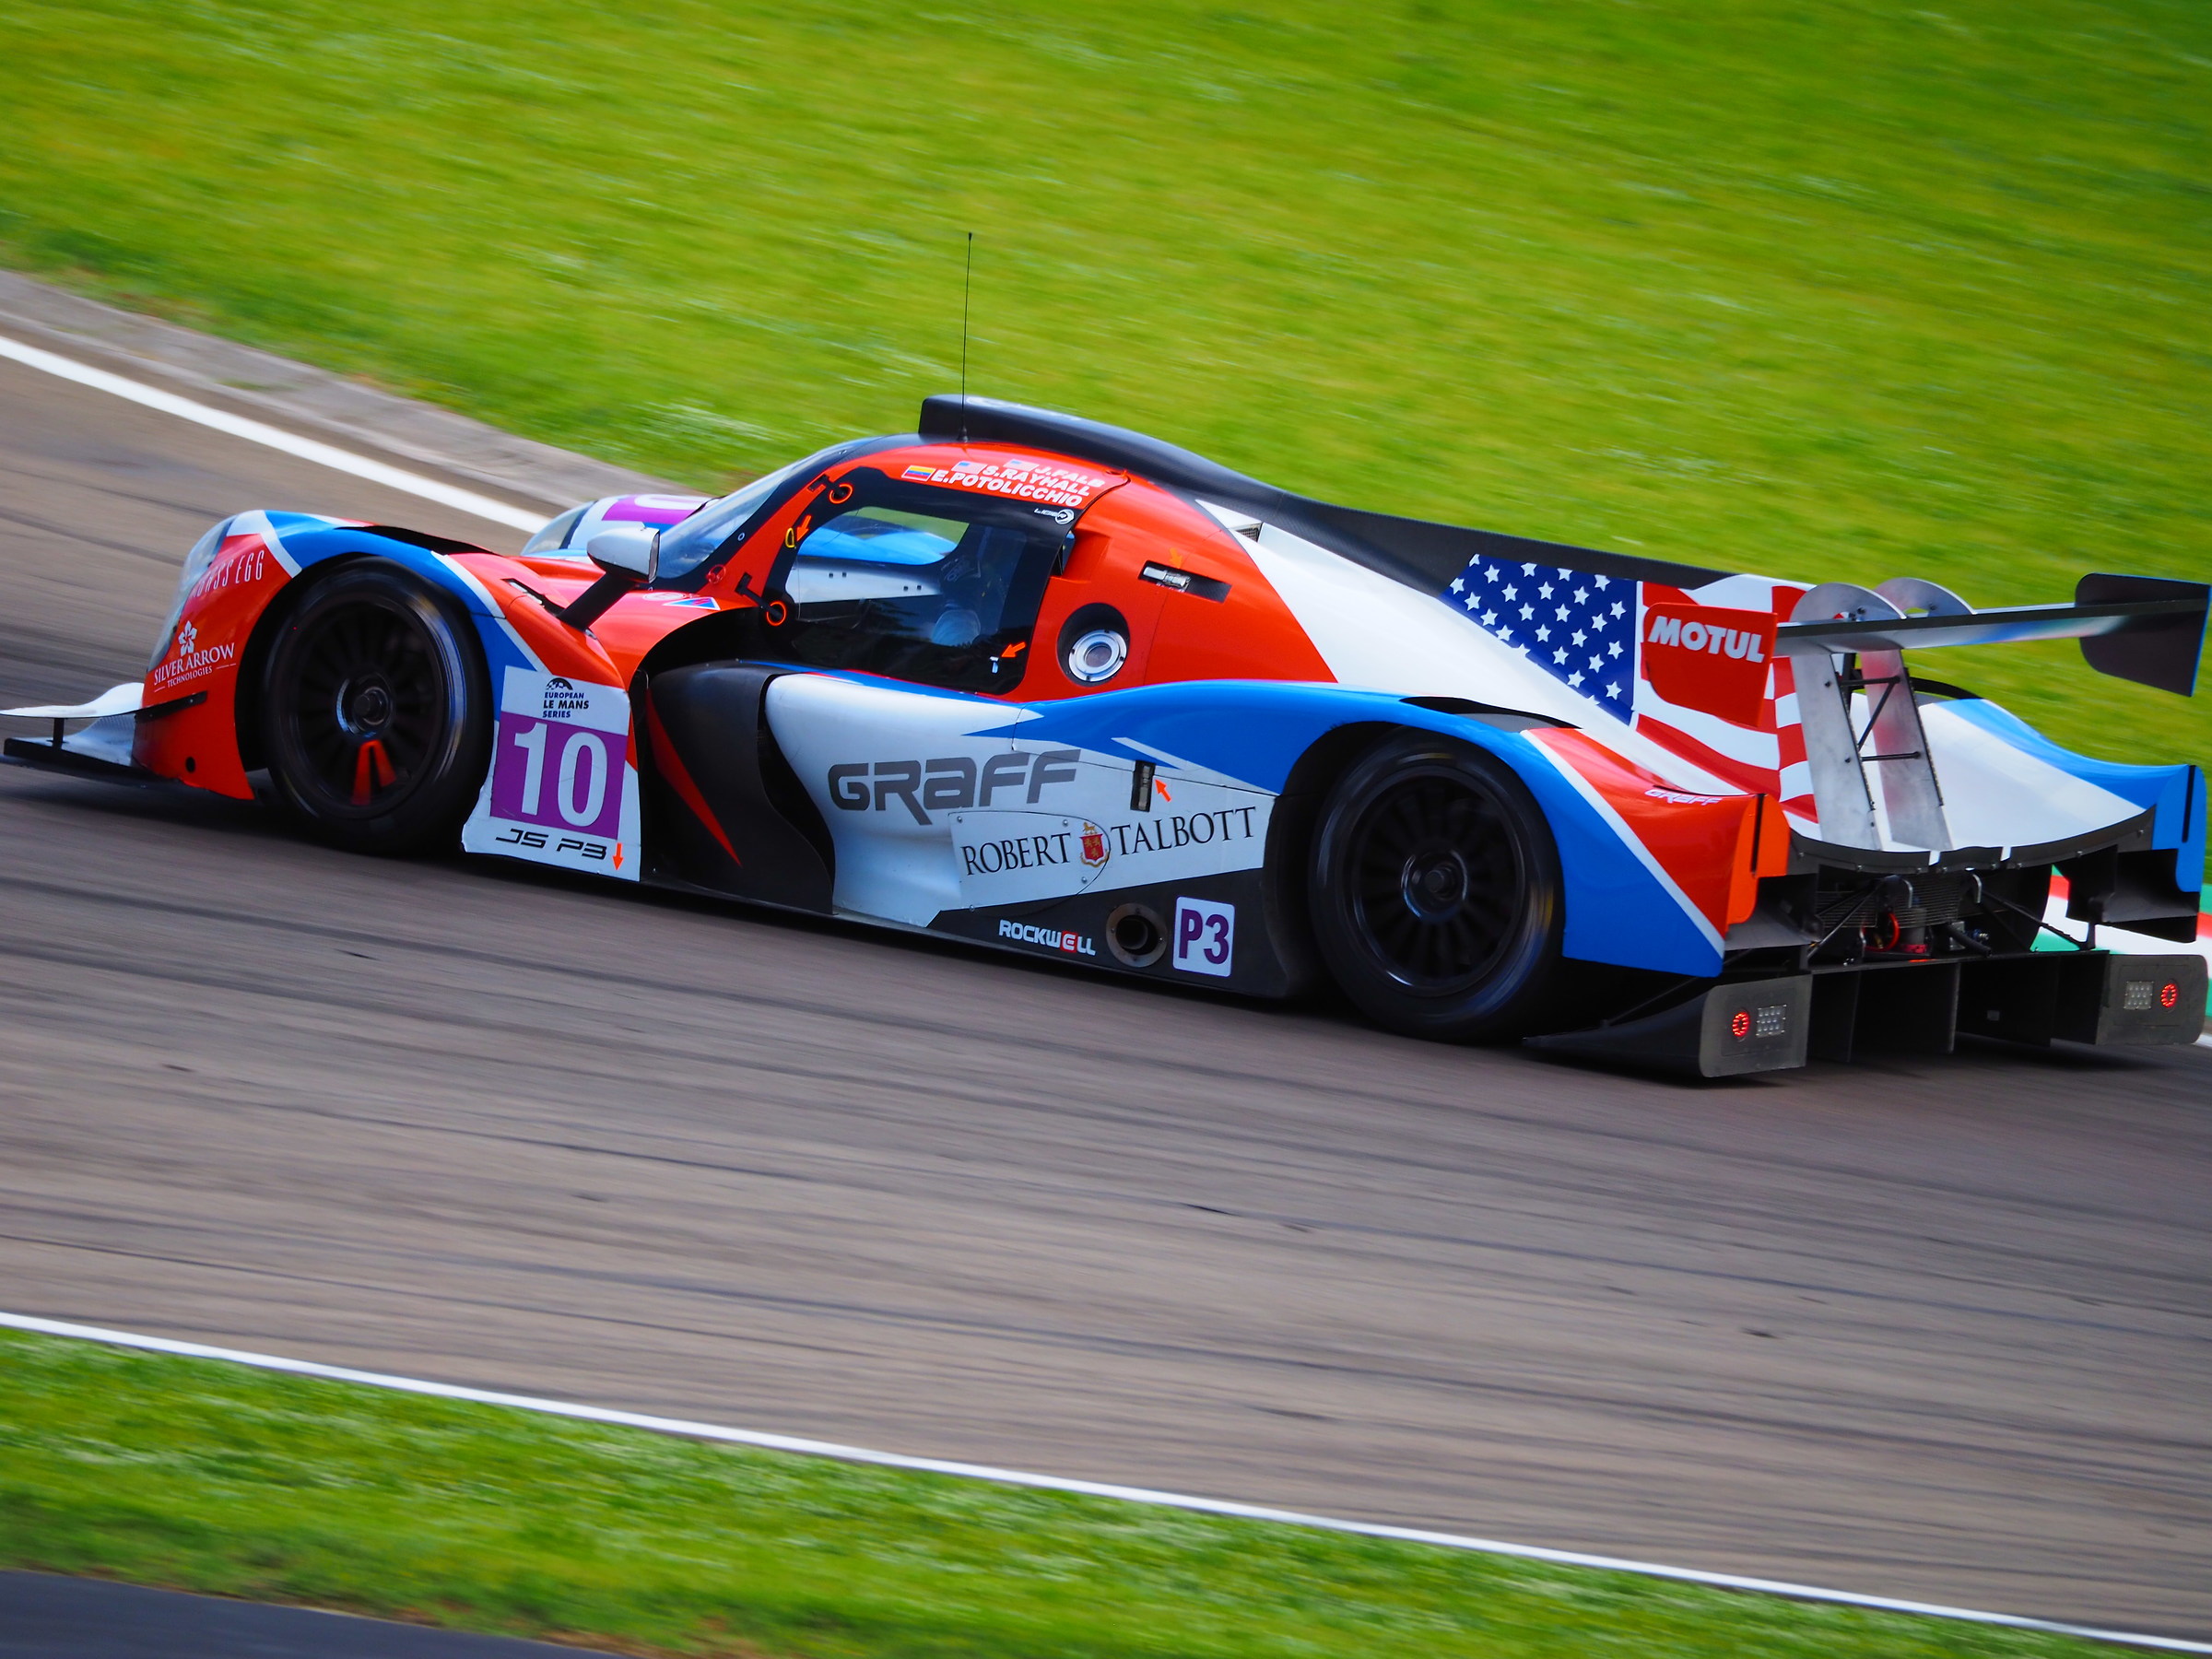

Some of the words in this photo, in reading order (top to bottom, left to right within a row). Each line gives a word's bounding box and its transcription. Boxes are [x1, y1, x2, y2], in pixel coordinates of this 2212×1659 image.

[931, 469, 1083, 507] E.POTOLICCHIO
[982, 465, 1090, 497] S.RAYHALL
[235, 550, 265, 584] EGG
[1648, 616, 1765, 663] MOTUL
[153, 658, 184, 686] SILVER
[185, 643, 235, 671] ARROW
[167, 665, 213, 688] TECHNOLOGIES
[543, 700, 556, 709] LE
[558, 700, 590, 710] MANS
[544, 691, 584, 700] EUROPEAN
[513, 722, 608, 828] 10
[495, 828, 549, 849] JS
[960, 833, 1071, 876] ROBERT
[1111, 806, 1257, 856] TALBOTT
[998, 918, 1097, 957] ROCKWELL
[1178, 908, 1230, 966] P3
